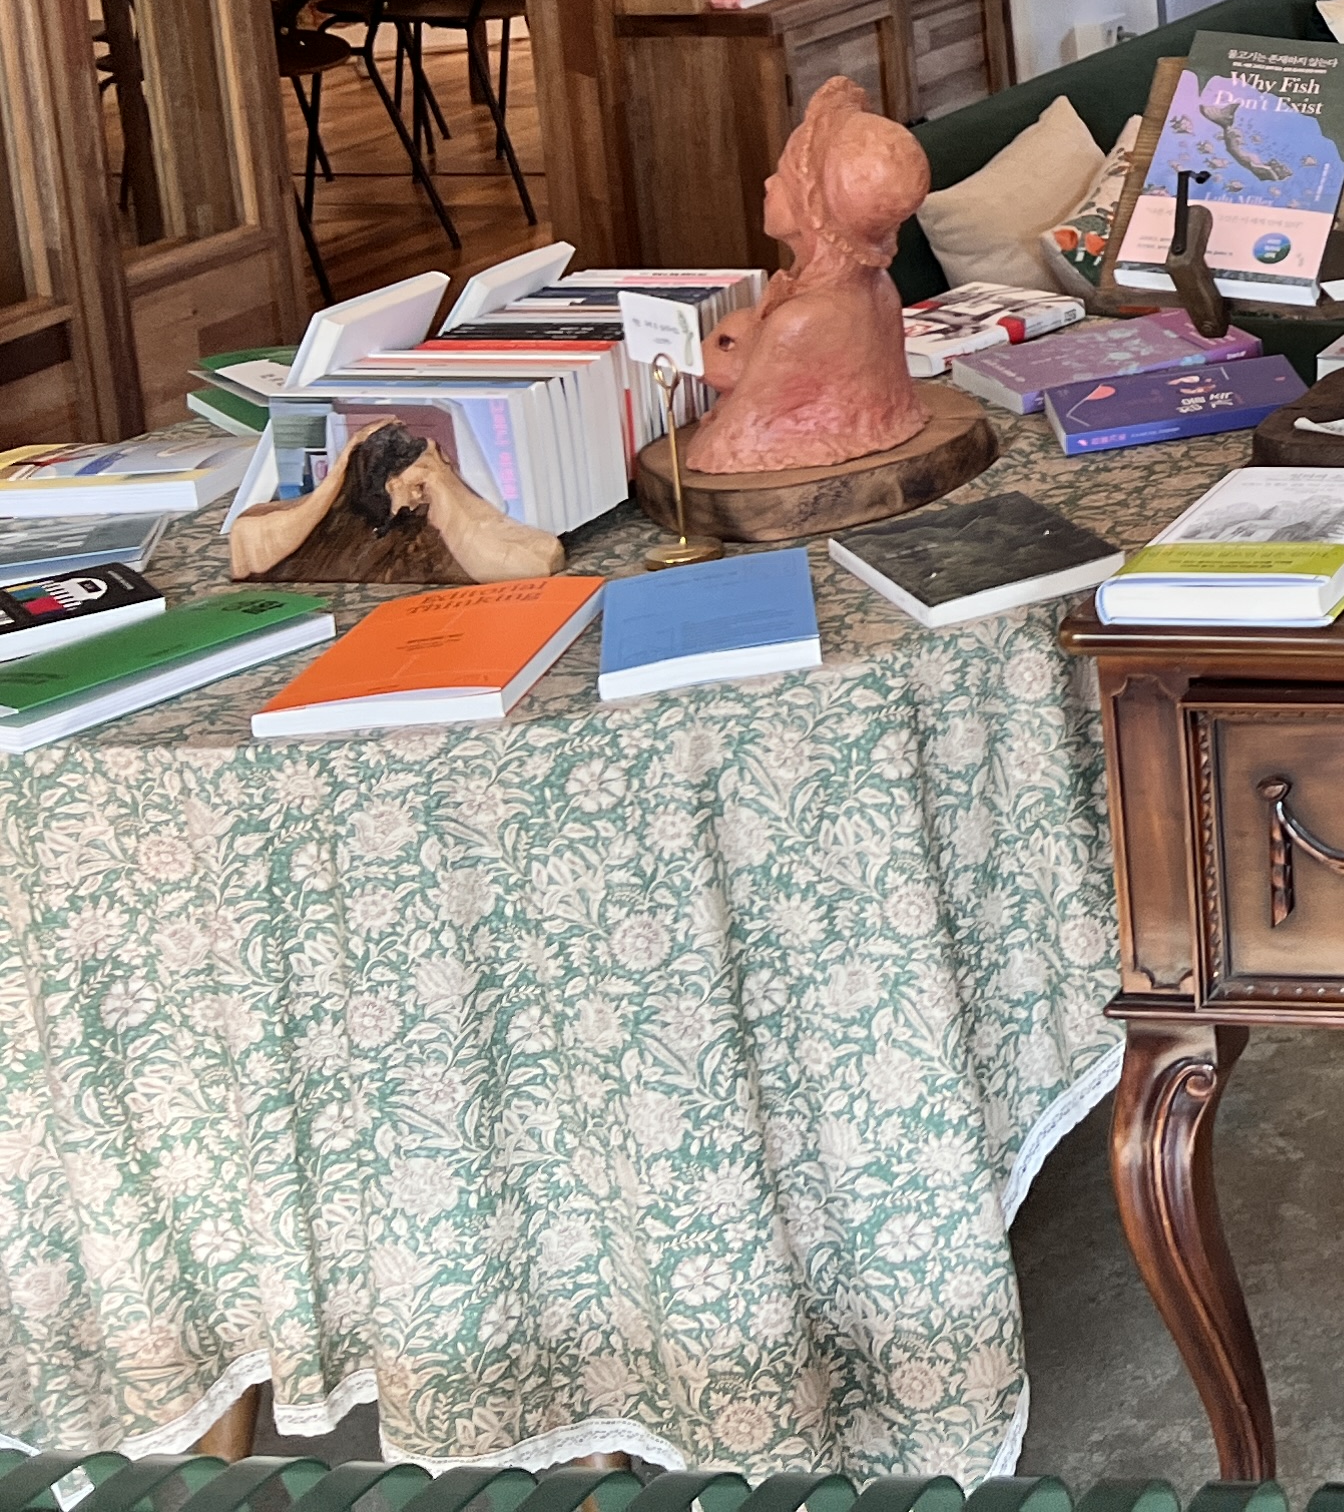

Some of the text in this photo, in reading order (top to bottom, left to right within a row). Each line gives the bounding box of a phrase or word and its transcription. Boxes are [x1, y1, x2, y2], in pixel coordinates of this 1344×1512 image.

[1228, 49, 1268, 63] 물고기는
[1268, 53, 1307, 67] 존재하지
[1308, 56, 1339, 68] 않는다
[1230, 70, 1321, 95] Why Fish
[1274, 96, 1325, 115] Exist
[406, 592, 542, 615] Thinking
[421, 580, 548, 605] Editorial
